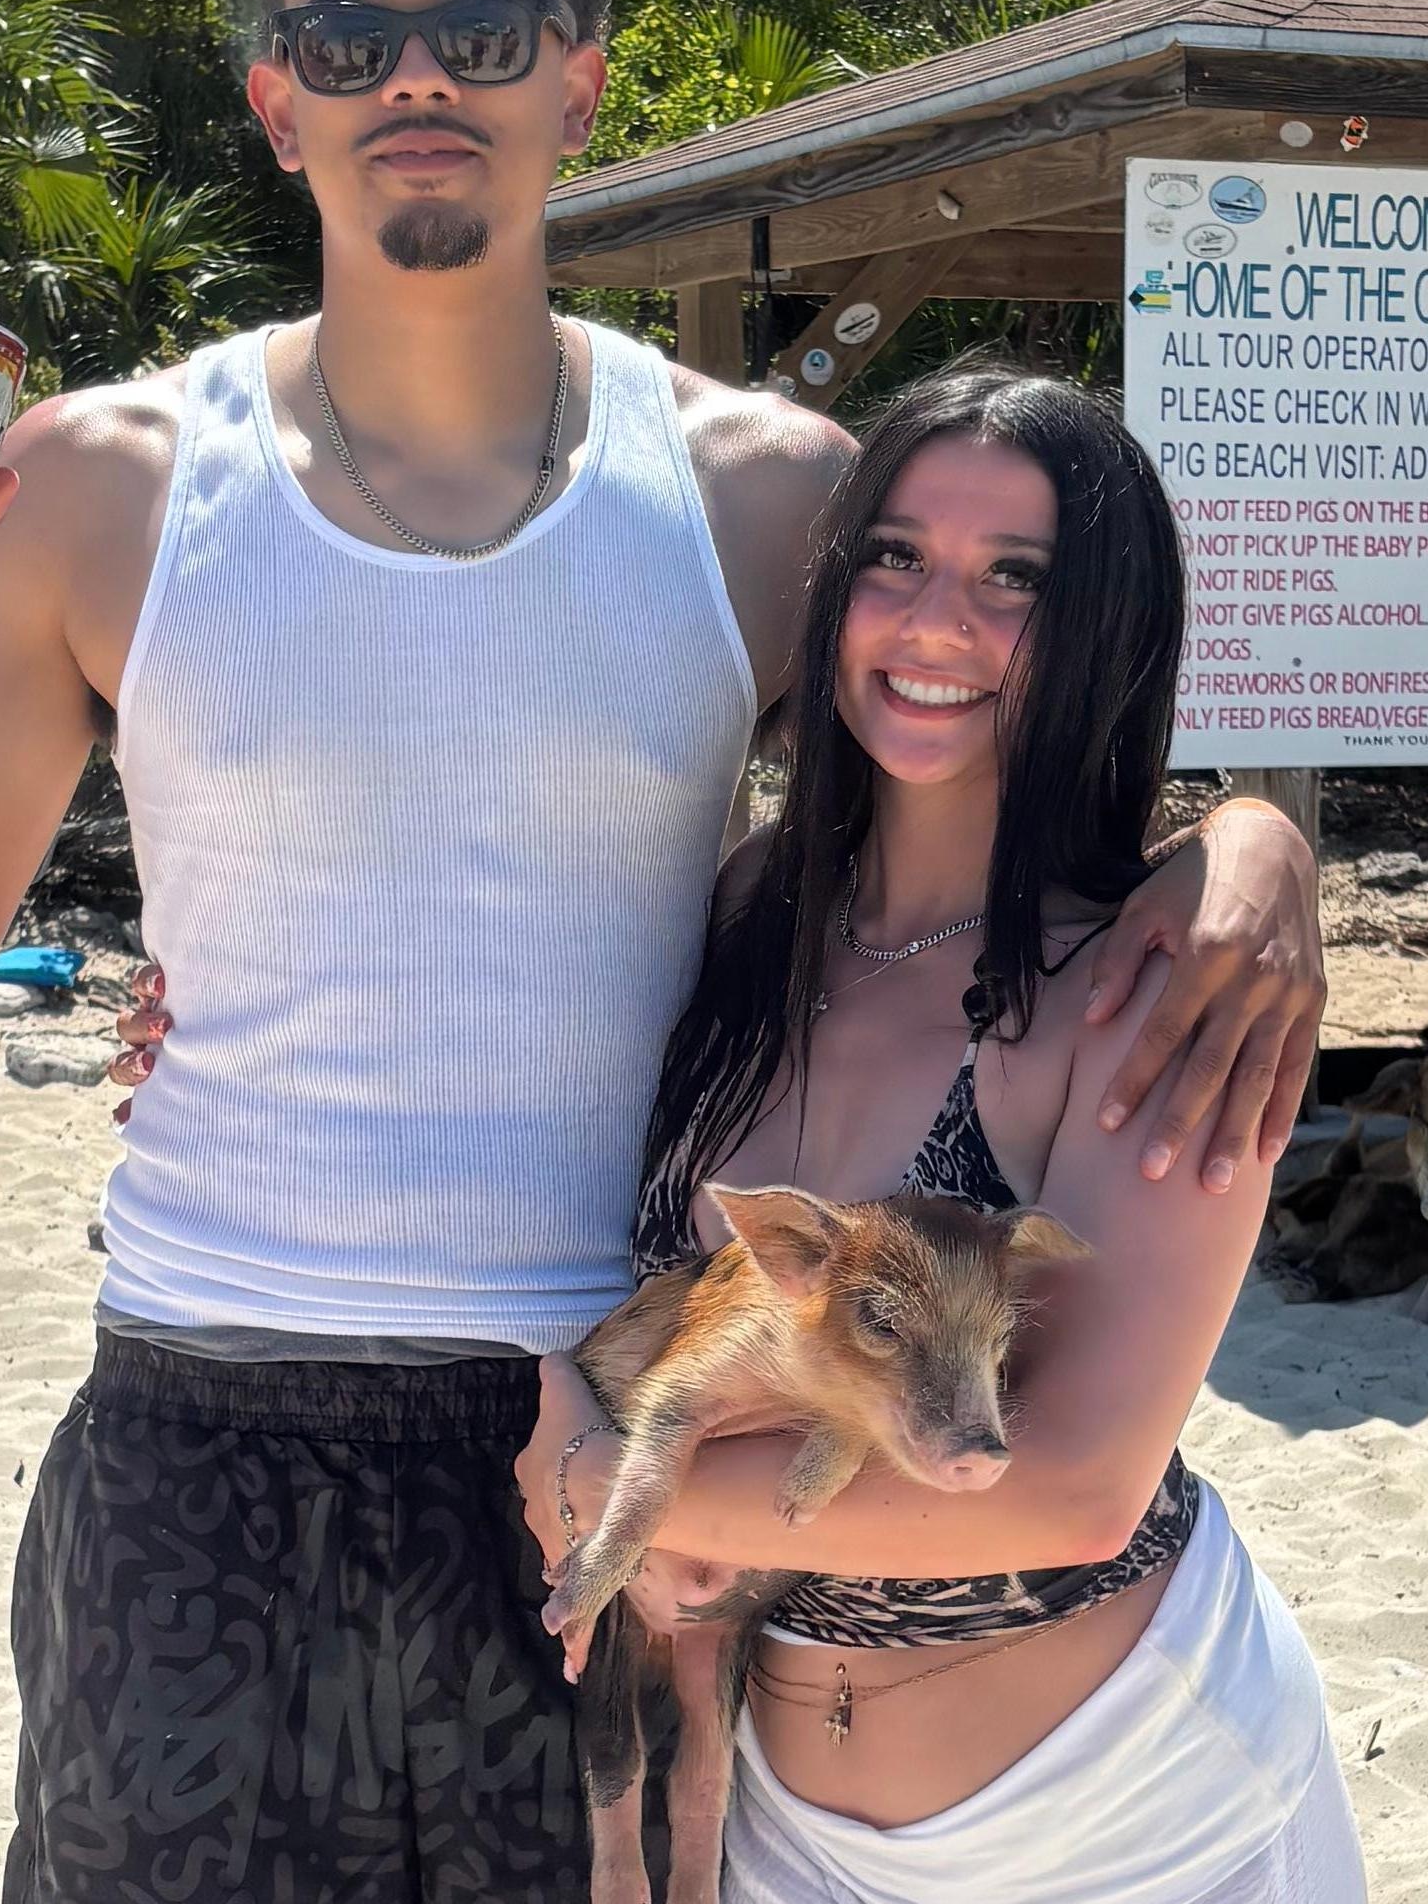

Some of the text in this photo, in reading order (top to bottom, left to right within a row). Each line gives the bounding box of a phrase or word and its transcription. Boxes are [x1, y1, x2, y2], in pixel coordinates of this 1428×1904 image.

[1168, 261, 1271, 320] HOME
[1281, 264, 1329, 321] OF
[1338, 266, 1406, 322] THE
[1162, 332, 1210, 367] ALL
[1219, 333, 1294, 369] TOUR
[1160, 387, 1265, 424] PLEASE
[1274, 389, 1368, 425] CHECK
[1376, 391, 1400, 426] IN
[1159, 442, 1205, 478] PIG
[1215, 443, 1306, 479] BEACH
[1315, 444, 1385, 480] VISIT:
[1198, 499, 1240, 522] NOT
[1244, 500, 1291, 523] FEED
[1297, 500, 1338, 523] PIGS
[1343, 500, 1372, 523] ON
[1378, 501, 1414, 523] THE
[1198, 535, 1240, 556] NOT
[1244, 535, 1288, 556] PICK
[1292, 535, 1317, 557] UP
[1323, 535, 1358, 557] THE
[1364, 536, 1412, 557] BABY
[1196, 569, 1238, 592] NOT
[1244, 569, 1286, 592] RIDE
[1196, 604, 1238, 626] NOT
[1242, 604, 1286, 626] GIVE
[1291, 604, 1333, 626] PIGS
[1197, 672, 1304, 695] FIREWORKS
[1309, 672, 1337, 695] OR
[1176, 708, 1213, 730] NLY
[1219, 707, 1265, 729] FEED
[1270, 707, 1312, 729] PIGS
[1344, 735, 1393, 746] THANK
